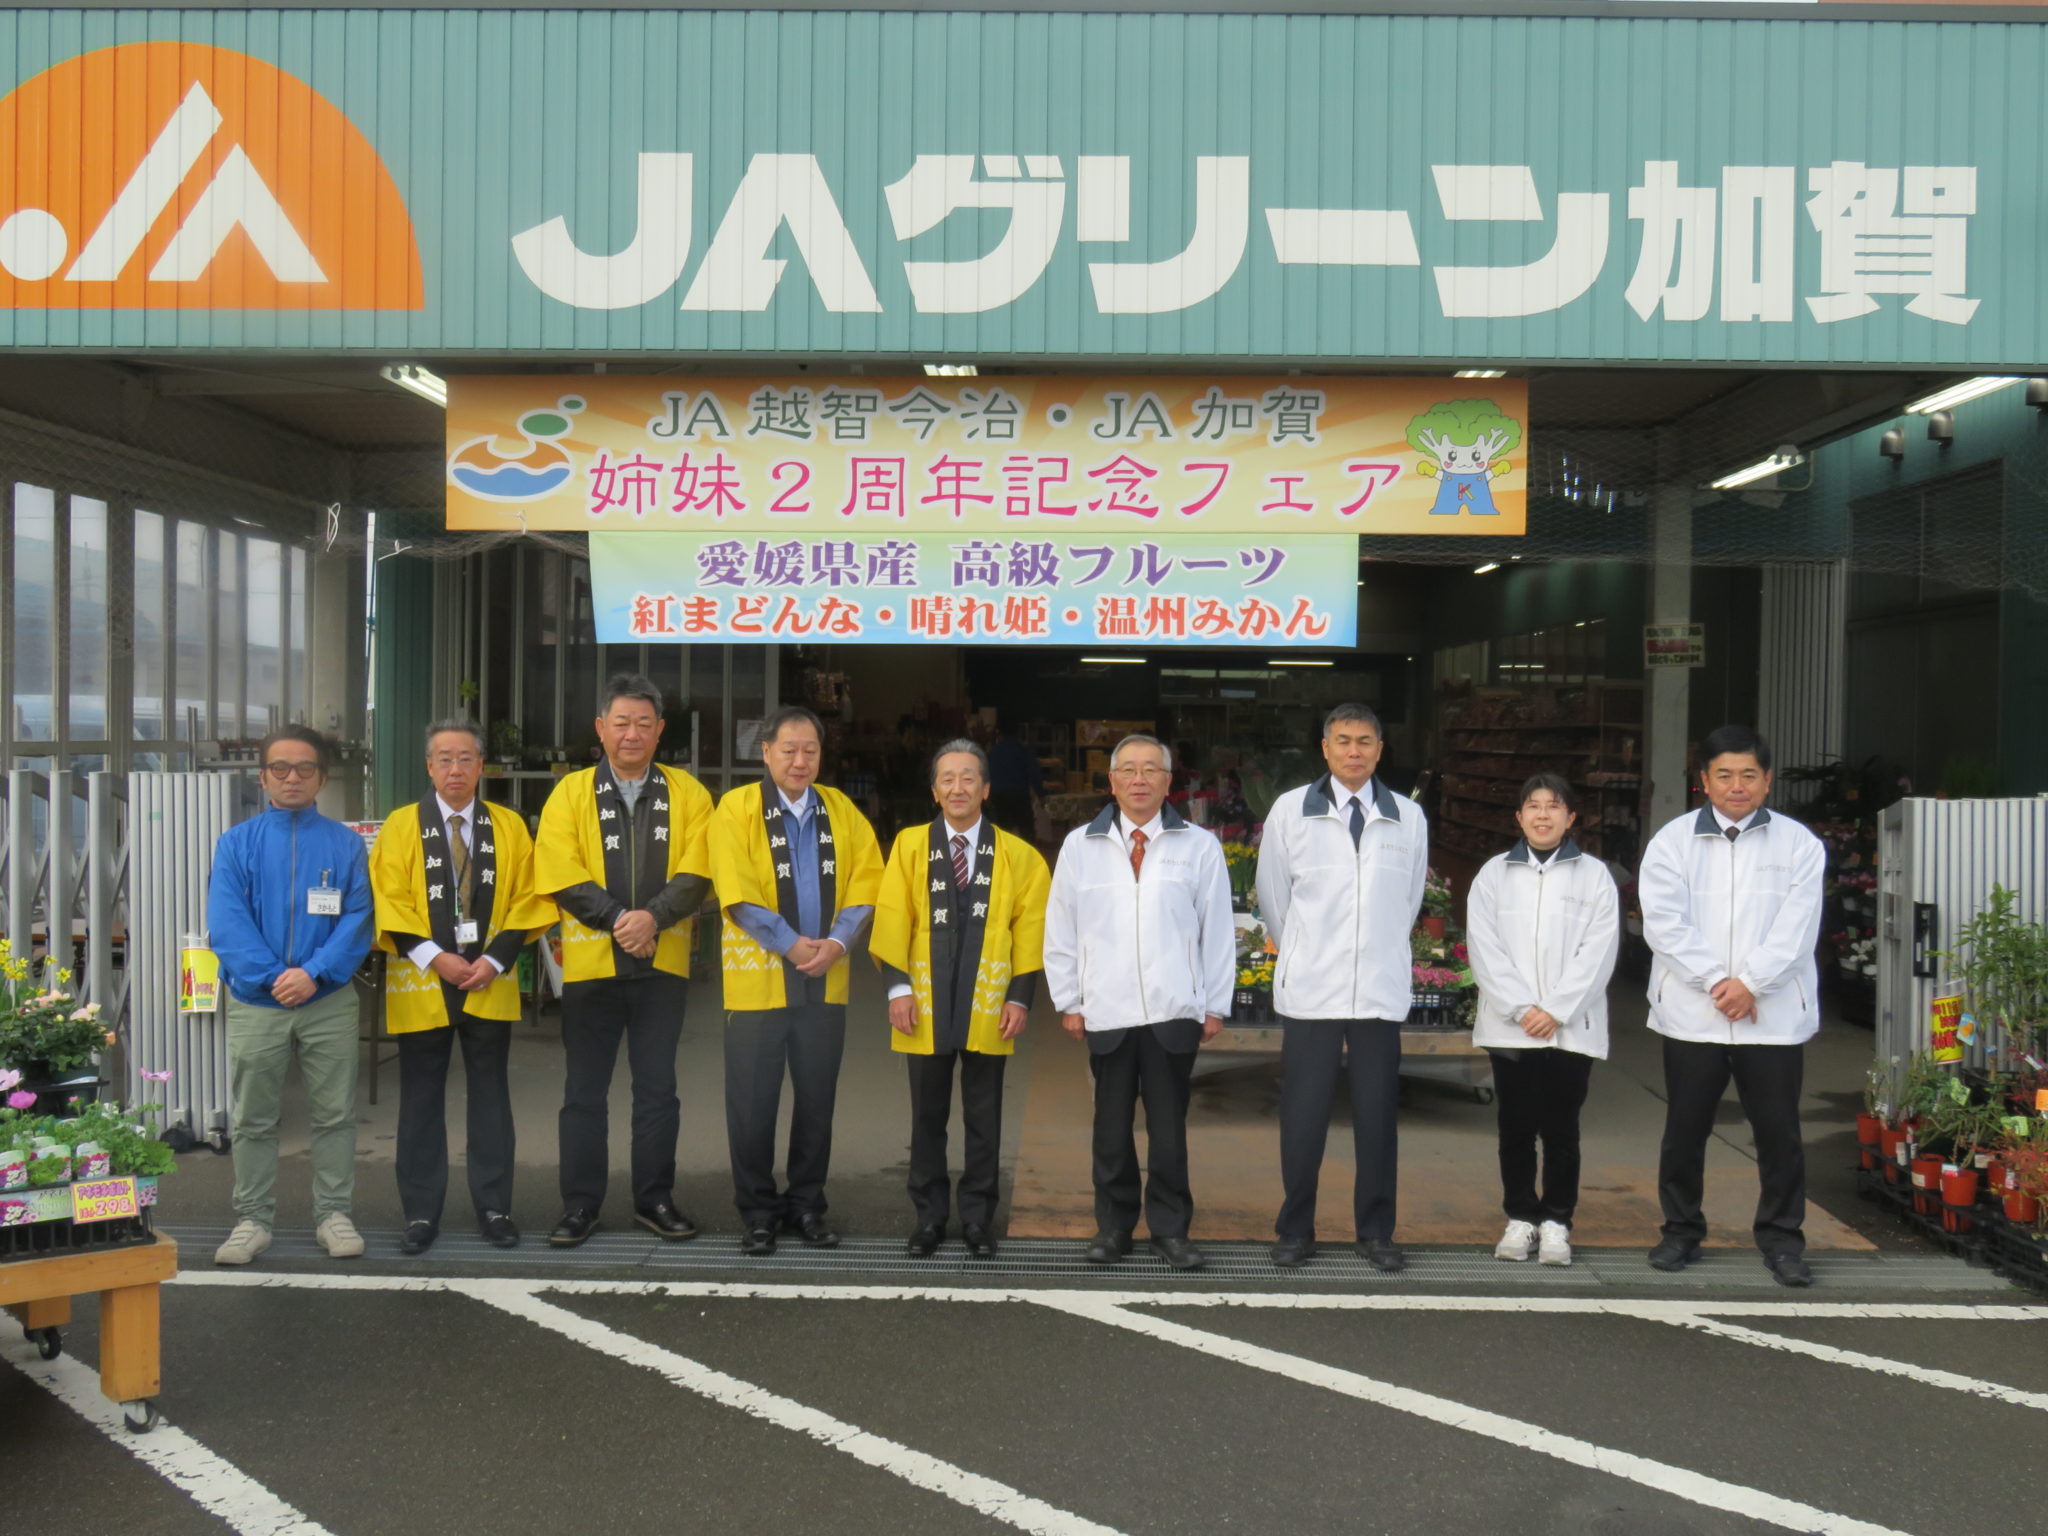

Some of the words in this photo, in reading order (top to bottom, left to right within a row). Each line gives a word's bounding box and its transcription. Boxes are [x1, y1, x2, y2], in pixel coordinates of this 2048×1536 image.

[510, 150, 1982, 326] JAグリーン加賀
[652, 390, 1321, 443] JA越智今治・JA加賀
[696, 540, 918, 588] 愛媛県産
[952, 541, 1286, 588] 高級フルーツ
[631, 595, 1328, 637] 紅まどんな・晴れ姫・温州みかん
[95, 1197, 130, 1216] 298
